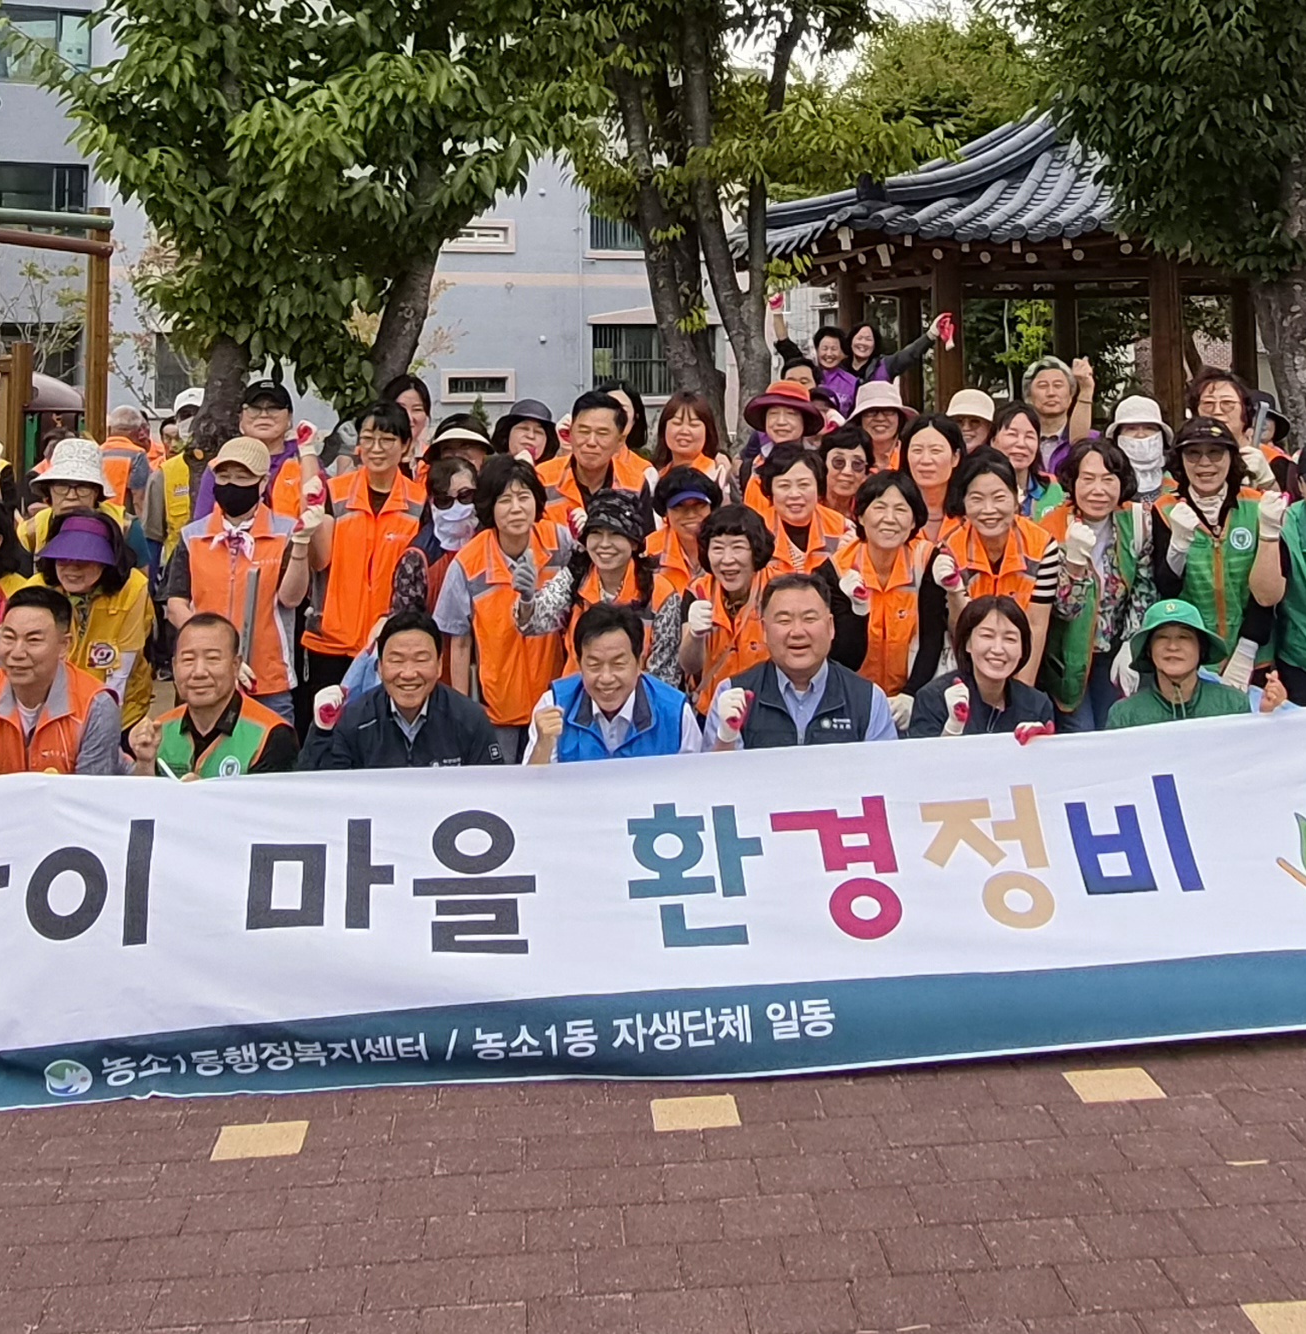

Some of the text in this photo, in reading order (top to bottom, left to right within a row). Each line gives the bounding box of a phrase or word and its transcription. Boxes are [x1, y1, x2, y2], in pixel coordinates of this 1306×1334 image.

[246, 810, 536, 954] 마을
[627, 774, 1204, 948] 환경정비
[101, 998, 836, 1087] 농소1동행정복지센터 / 농소1동 자생단체 일동
